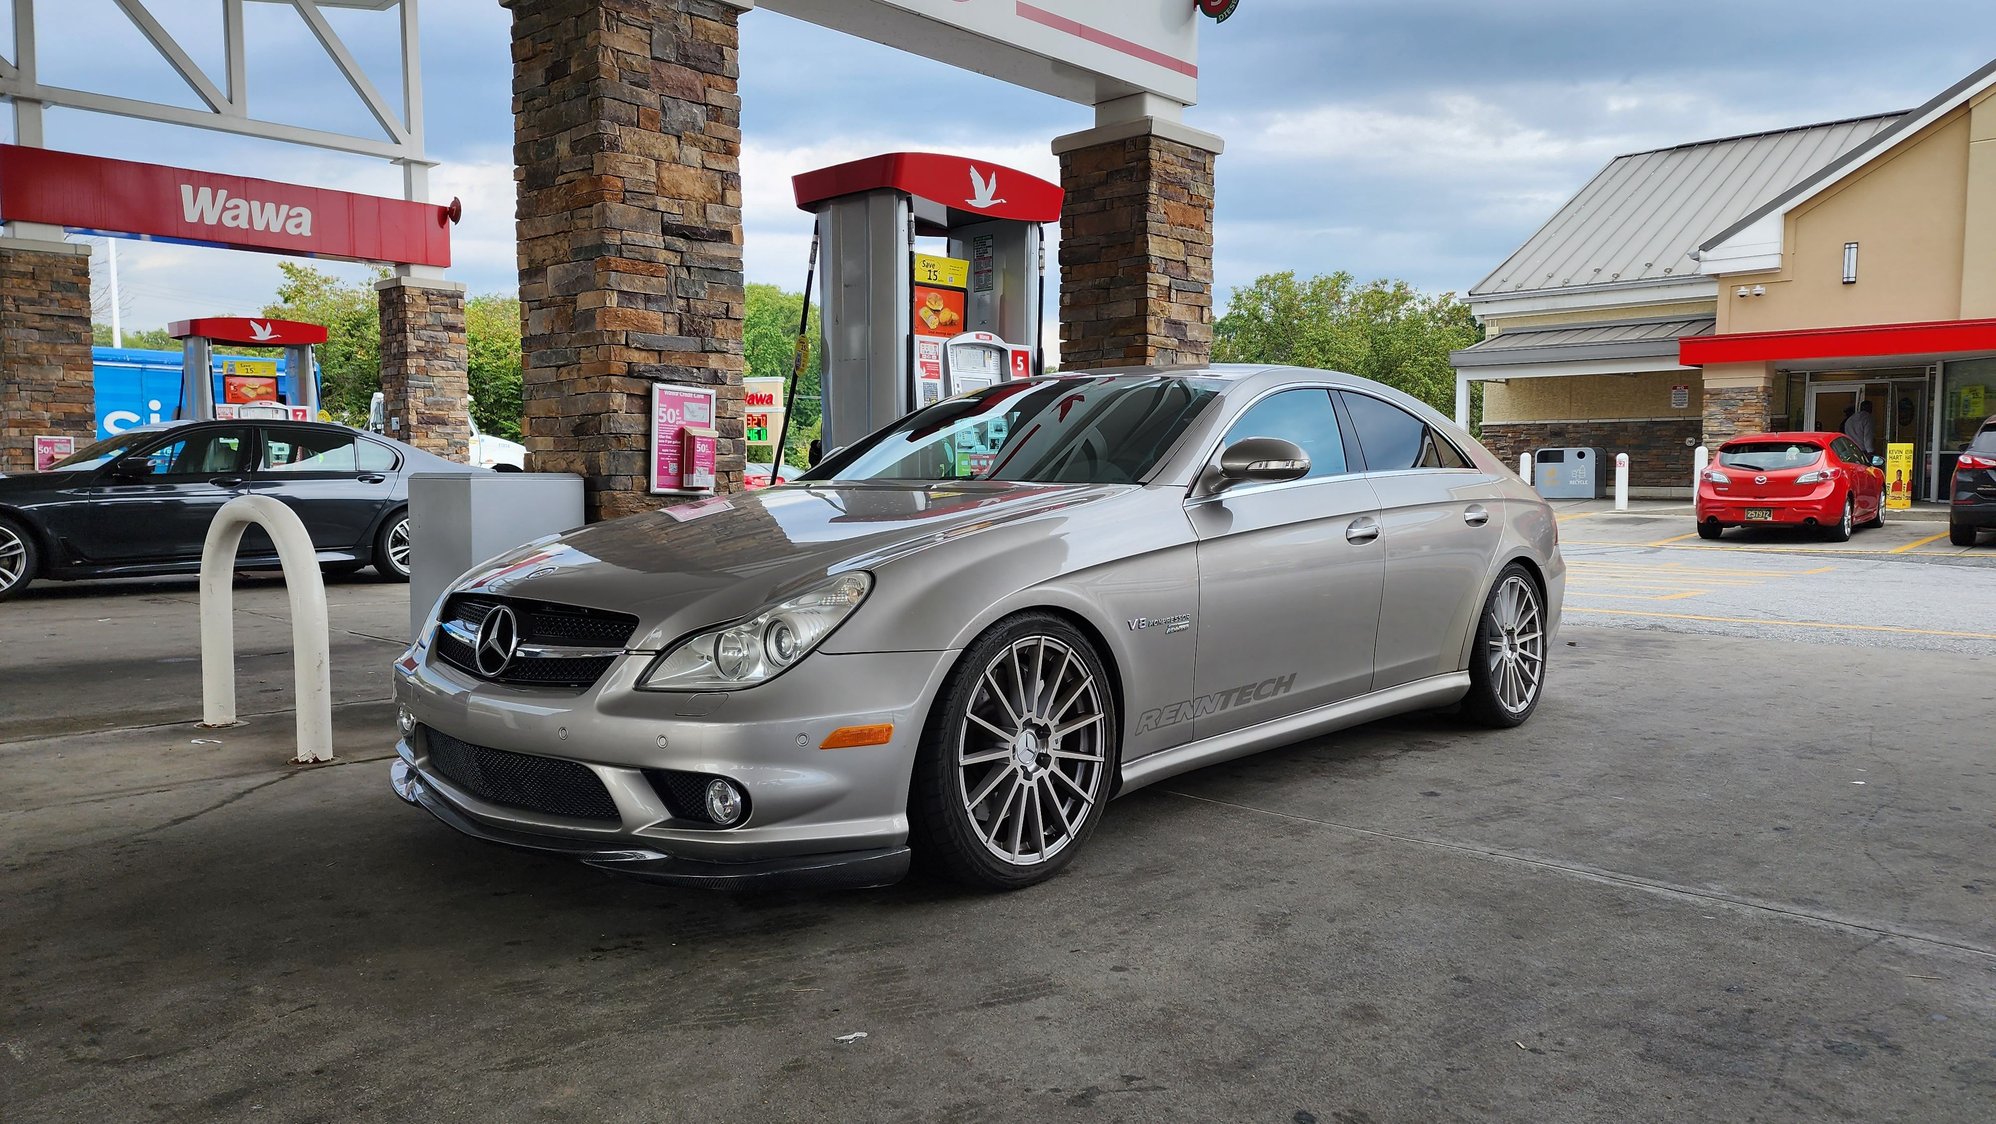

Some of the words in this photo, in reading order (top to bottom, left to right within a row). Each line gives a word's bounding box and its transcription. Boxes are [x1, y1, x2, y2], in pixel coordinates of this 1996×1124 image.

[180, 184, 312, 237] Wawa
[922, 260, 936, 269] Save
[1016, 356, 1024, 371] 5
[744, 392, 773, 406] awa
[295, 412, 304, 420] 7
[1134, 672, 1297, 736] RENNTECH
